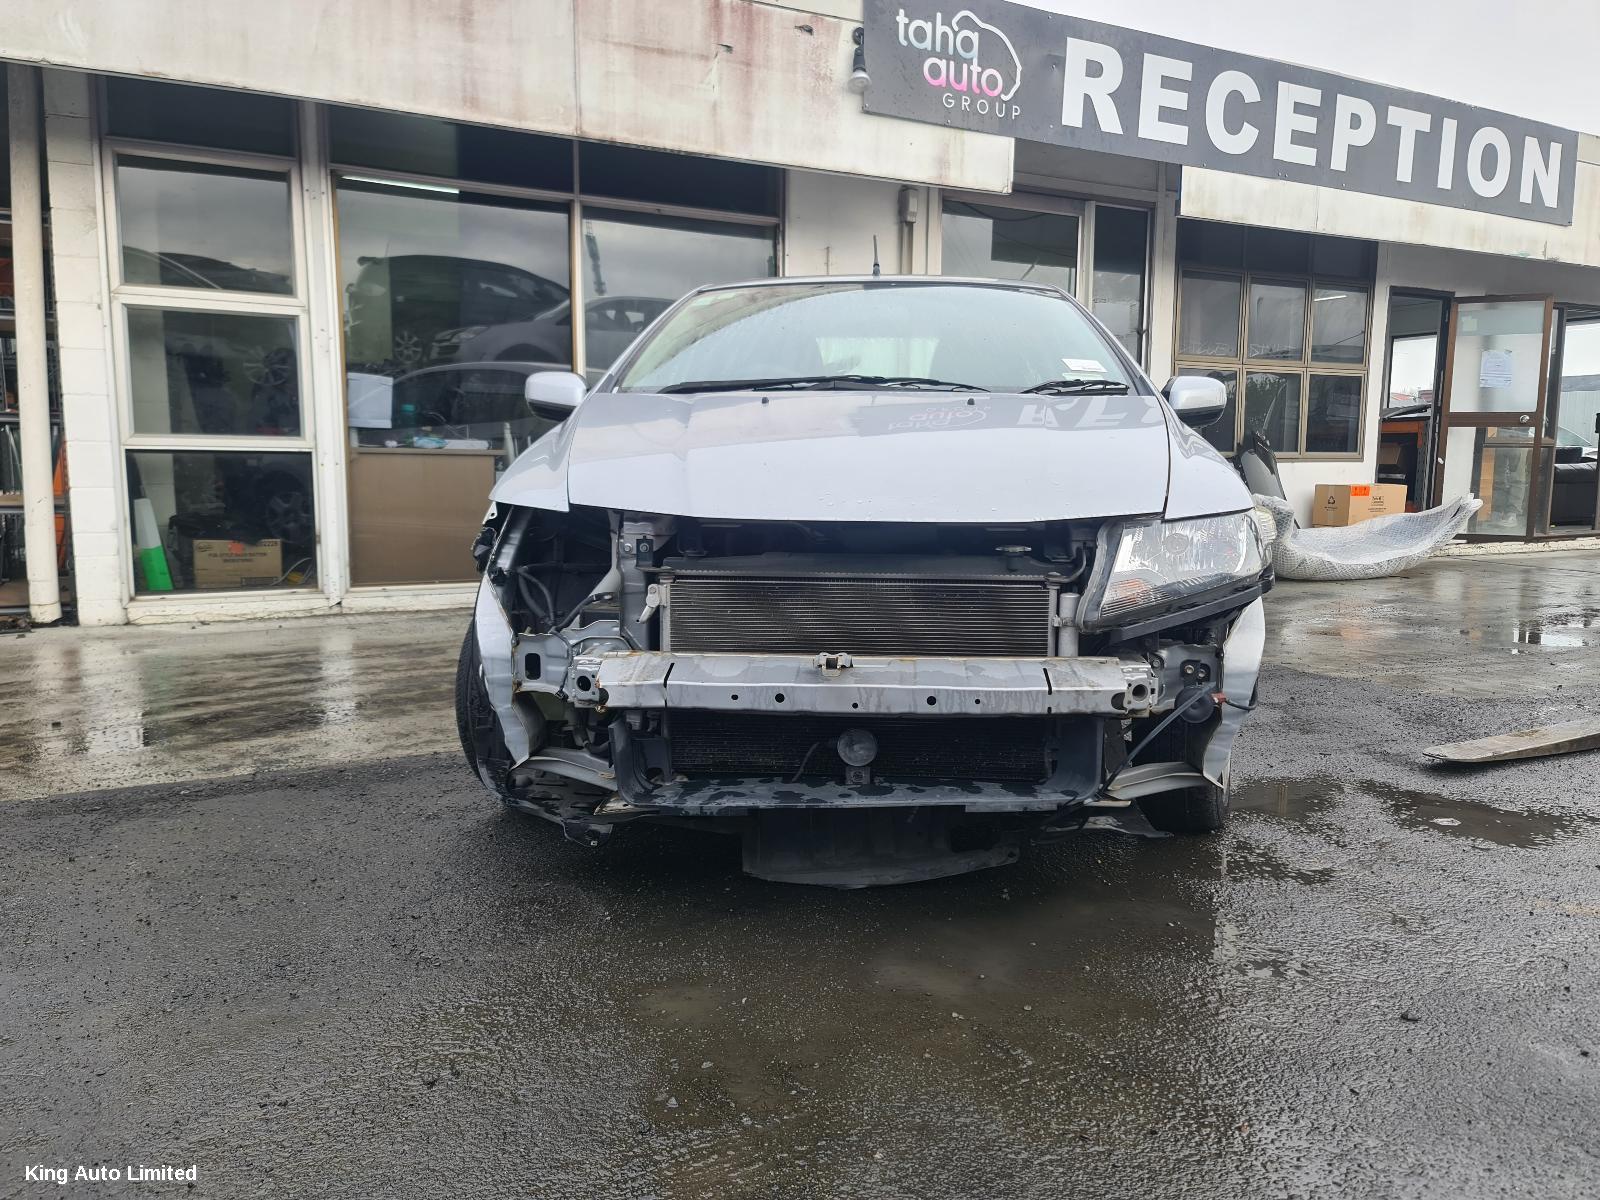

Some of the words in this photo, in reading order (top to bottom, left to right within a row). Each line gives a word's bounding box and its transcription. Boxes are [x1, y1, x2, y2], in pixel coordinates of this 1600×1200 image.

[896, 9, 979, 59] taha
[923, 57, 1003, 97] auto
[942, 92, 1021, 120] GROUP
[1061, 37, 1563, 209] RECEPTION
